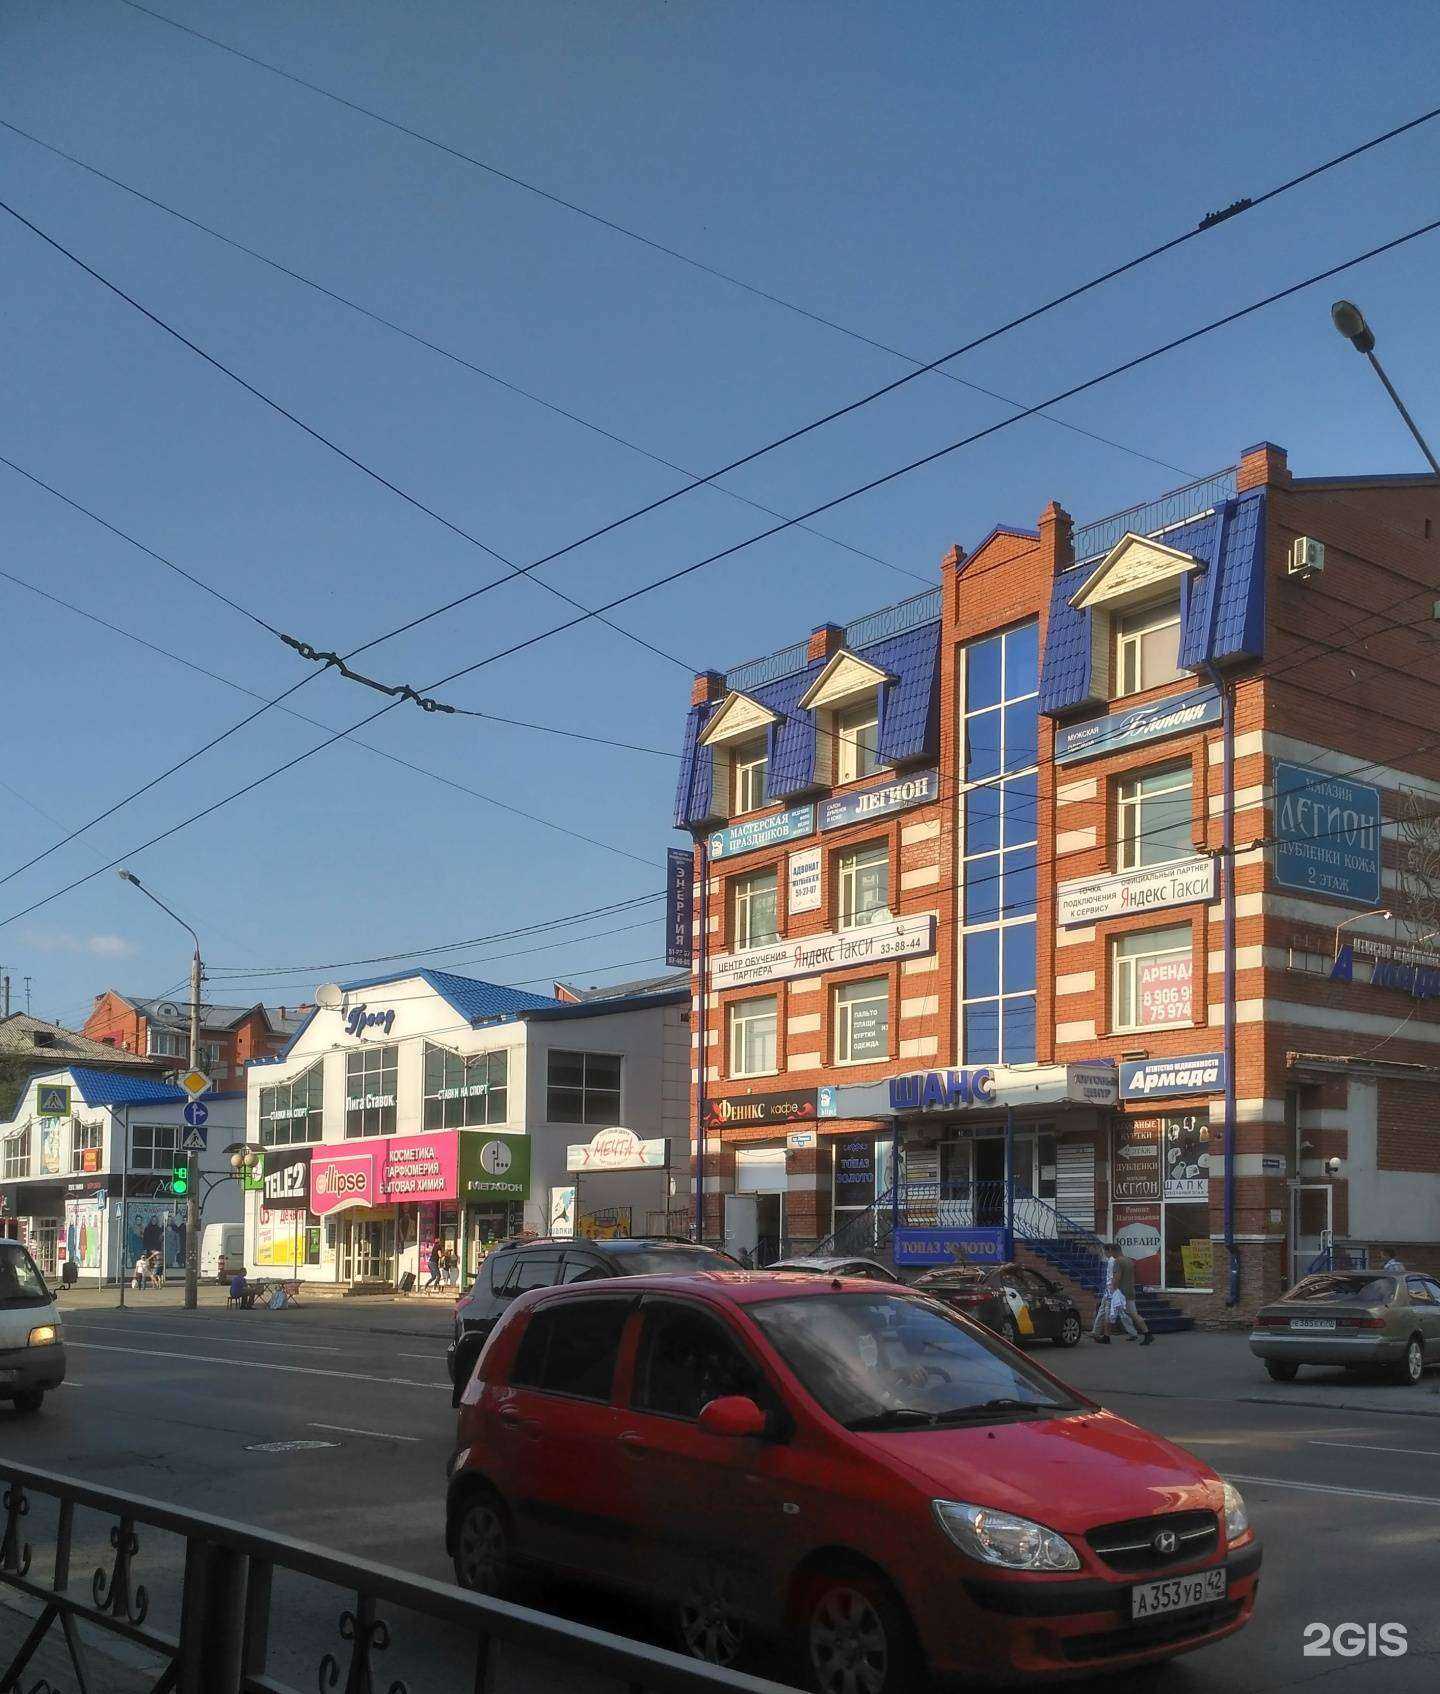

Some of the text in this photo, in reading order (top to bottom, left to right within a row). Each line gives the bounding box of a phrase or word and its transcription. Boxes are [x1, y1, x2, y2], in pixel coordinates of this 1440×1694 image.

[730, 814, 788, 838] МАСТЕРСКАЯ
[1281, 795, 1374, 851] ЛЕГИОН
[730, 826, 789, 850] ПРАЗДНИКОВ
[1280, 841, 1376, 873] ДУБЛЕНКИ КОЖА
[793, 862, 819, 876] АДВОКАТ
[1121, 863, 1209, 886] ОФИЦИАЛЬНЫЙ ПАРТНЕР
[1308, 867, 1349, 891] 2 ЭТАЖ
[1064, 893, 1116, 908] ПОДКЛЮЧЕНИЯ
[1121, 877, 1209, 908] Яндекс Такси
[676, 868, 685, 945] ЭНЕРГИЯ
[1076, 904, 1109, 916] СЕРВИСУ
[794, 938, 921, 968] Яндекс Такси 33-88-44
[718, 952, 786, 973] ЦЕНТР ОБУЧЕНИЯ
[733, 967, 772, 980] ПАРТНЕРА
[1144, 986, 1192, 1006] 8 906 9
[854, 1020, 876, 1028] ПЛАЩИ
[854, 1040, 880, 1050] ОДЕЖДА
[890, 1068, 996, 1109] ШАНС
[1129, 1068, 1218, 1093] Армада
[438, 1084, 488, 1100] СТАВКИ НА СПОРТ
[347, 1094, 394, 1110] Лига Ставок
[771, 1102, 798, 1116] кафе
[294, 1108, 308, 1118] СПОРТ
[390, 1147, 435, 1162] КОСМЕТИКА
[594, 1136, 635, 1157] МЕЧТА
[174, 1168, 187, 1178] 48
[385, 1162, 439, 1178] ПАРФЮМЕРИЯ
[265, 1162, 306, 1198] TELE2
[380, 1178, 444, 1194] БЫТОВАЯ ХИМИЯ
[1164, 1181, 1204, 1190] ШАПК
[1116, 1182, 1158, 1195] ЛЕГИОН
[904, 1241, 940, 1254] ТОПАЗ
[1116, 1237, 1161, 1246] ЮВЕЛИР
[1138, 1572, 1222, 1613] А353УВ 42
